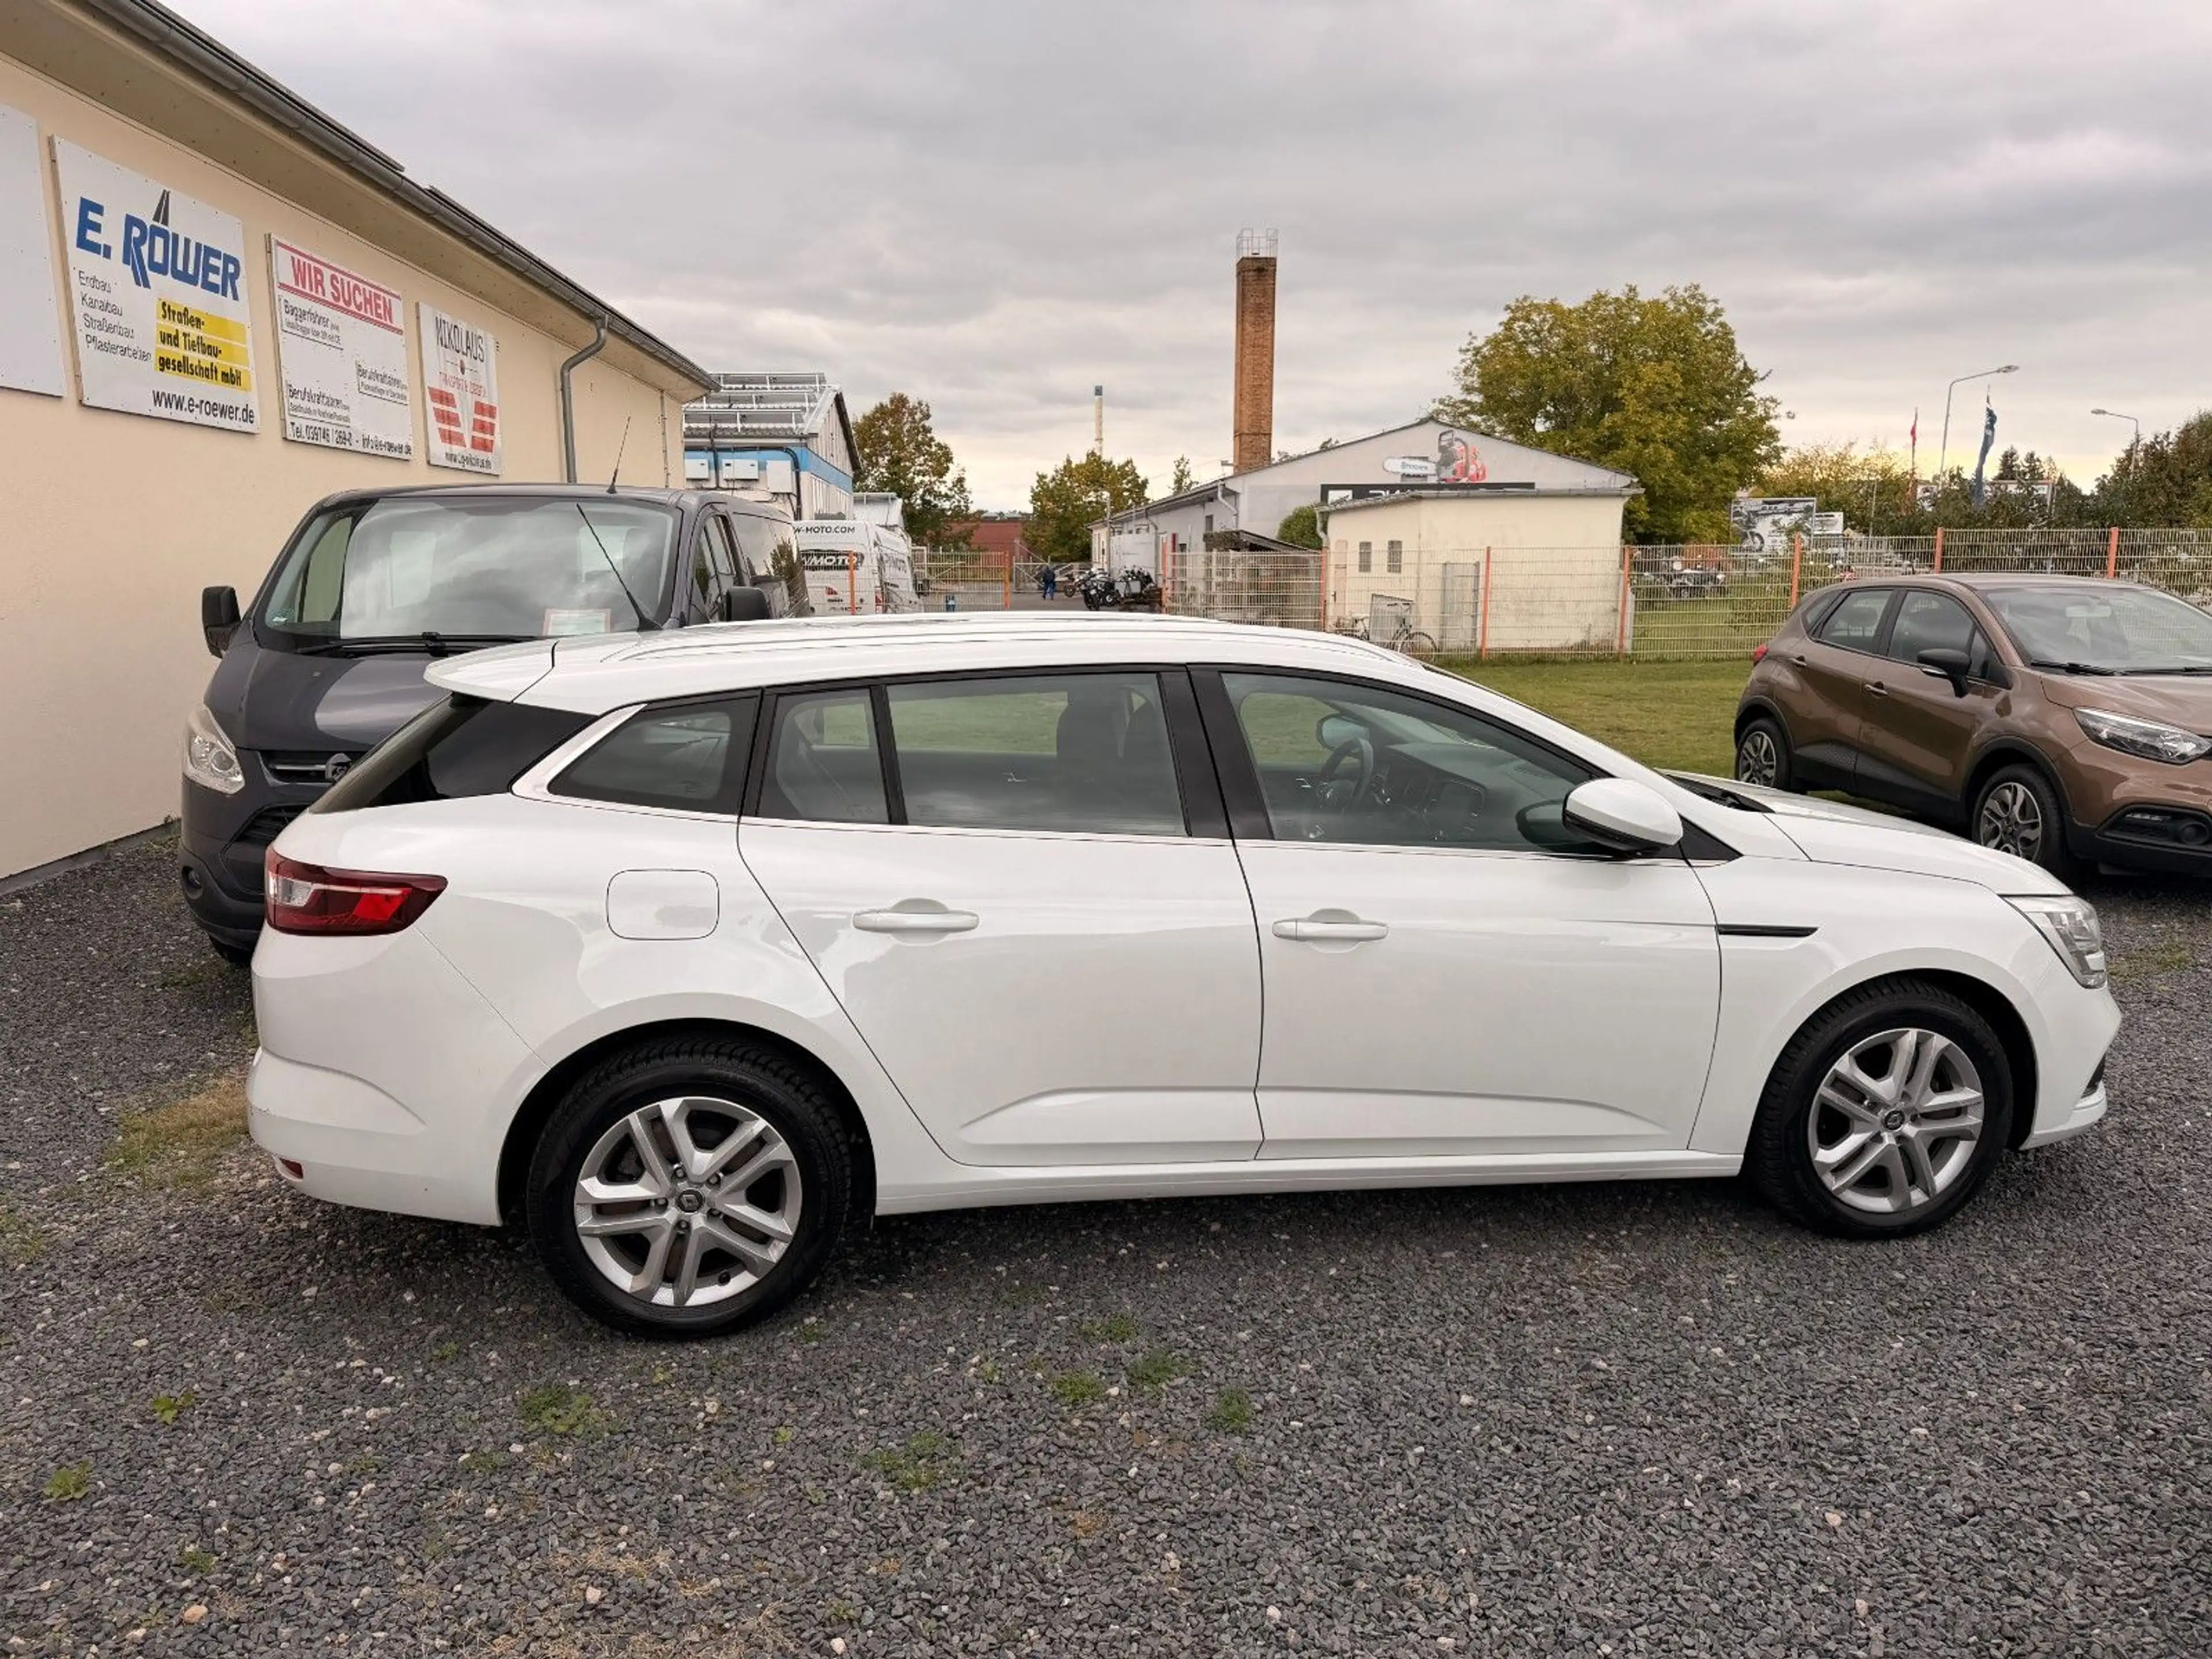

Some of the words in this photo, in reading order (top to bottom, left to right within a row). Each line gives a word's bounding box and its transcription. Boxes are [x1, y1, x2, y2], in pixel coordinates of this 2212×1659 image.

[76, 196, 111, 260] E.
[78, 270, 111, 293] Erdbau
[290, 255, 325, 297] WIR
[330, 273, 393, 324] SUCHEN
[81, 293, 123, 316] Kanalbau
[161, 301, 204, 329] Straßen-
[83, 313, 134, 339] Straßenbau
[435, 316, 484, 363] NIKOLAUS
[85, 334, 151, 362] Pflasterarbeiten
[159, 329, 180, 348] und
[183, 331, 222, 358] Tiefbau-
[158, 355, 218, 381] gesellschaft
[221, 368, 242, 387] mbH
[152, 389, 255, 424] www.e-roewer.de
[290, 422, 305, 439] Tel.
